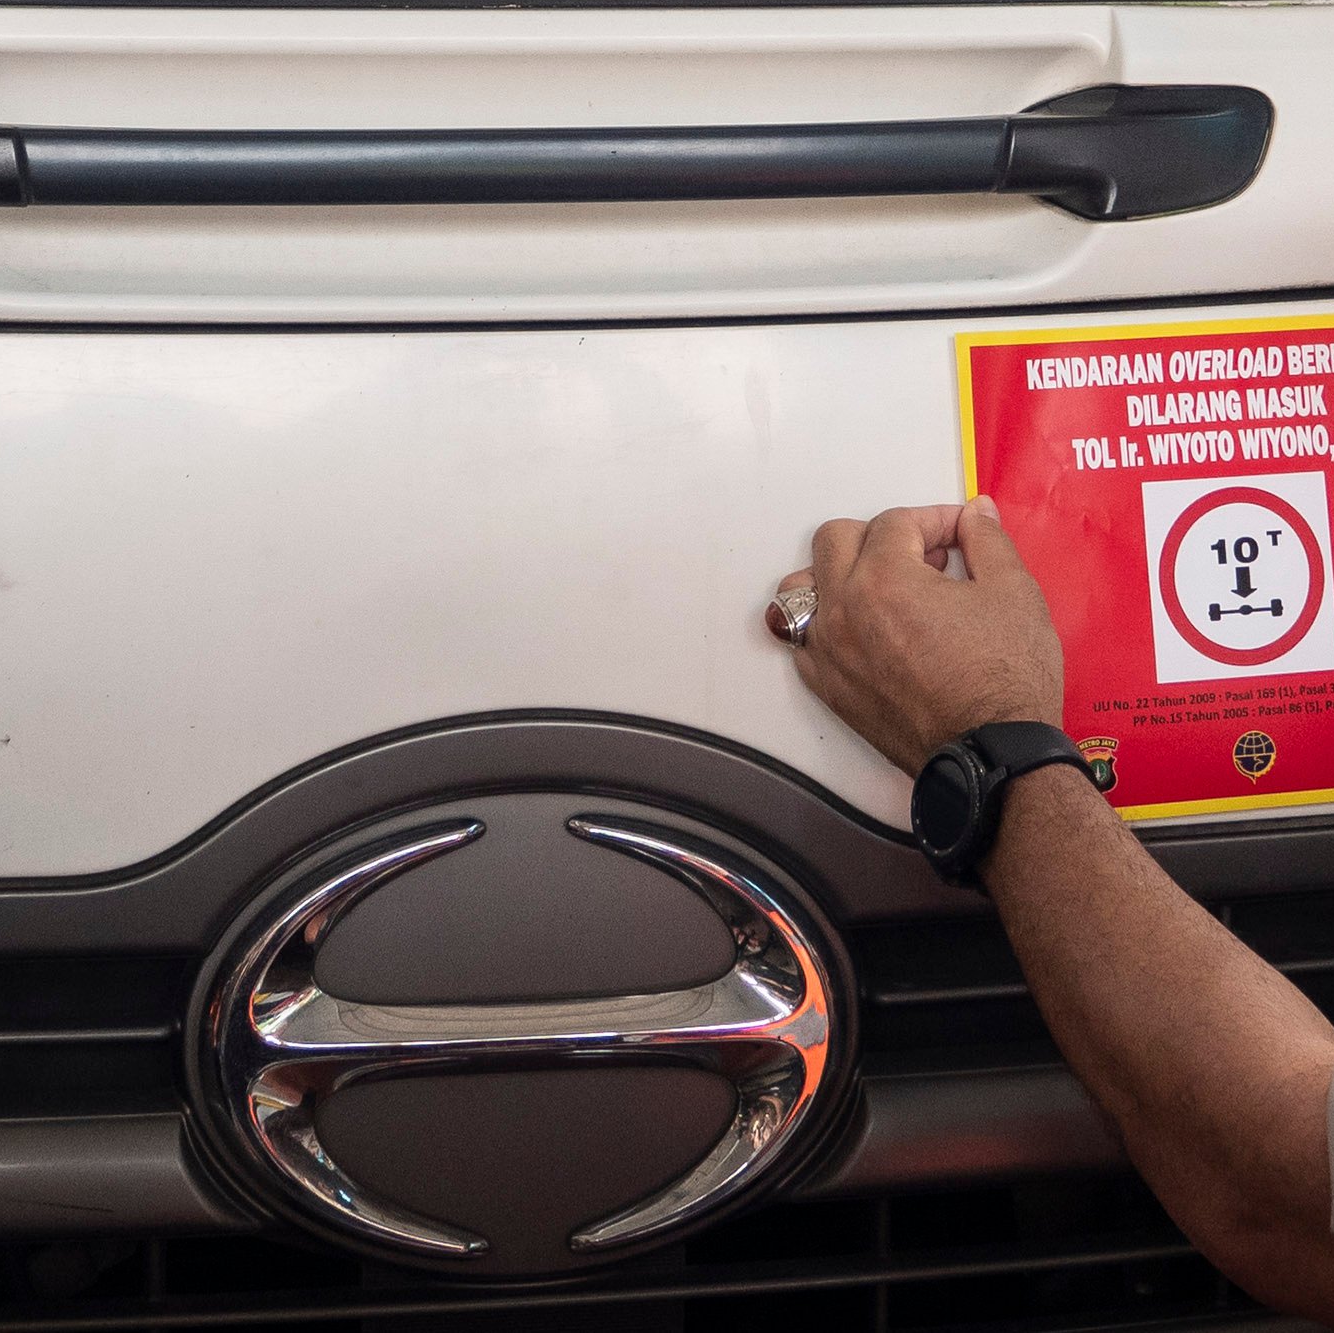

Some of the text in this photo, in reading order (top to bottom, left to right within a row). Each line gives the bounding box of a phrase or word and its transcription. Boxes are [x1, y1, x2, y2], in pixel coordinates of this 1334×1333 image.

[1025, 352, 1164, 390] KENDARAAN
[1169, 346, 1284, 382] OVERLOAD
[1126, 385, 1328, 427] DILARANG MASUK
[1072, 438, 1116, 470] TOL
[1119, 435, 1145, 467] Ir.
[1147, 430, 1235, 466] WIYOTO
[1210, 529, 1282, 565] 10 T
[1092, 701, 1110, 713] UU
[1113, 700, 1133, 710] No.
[1136, 697, 1150, 709] 22
[1152, 696, 1186, 708] Tahun
[1189, 693, 1216, 705] 2009
[1225, 689, 1253, 701] Pasal
[1299, 683, 1327, 695] Pasal
[1133, 716, 1147, 727] PP
[1185, 710, 1220, 722] Tahun
[1223, 707, 1249, 719] 2005
[1258, 704, 1286, 716] Pasal
